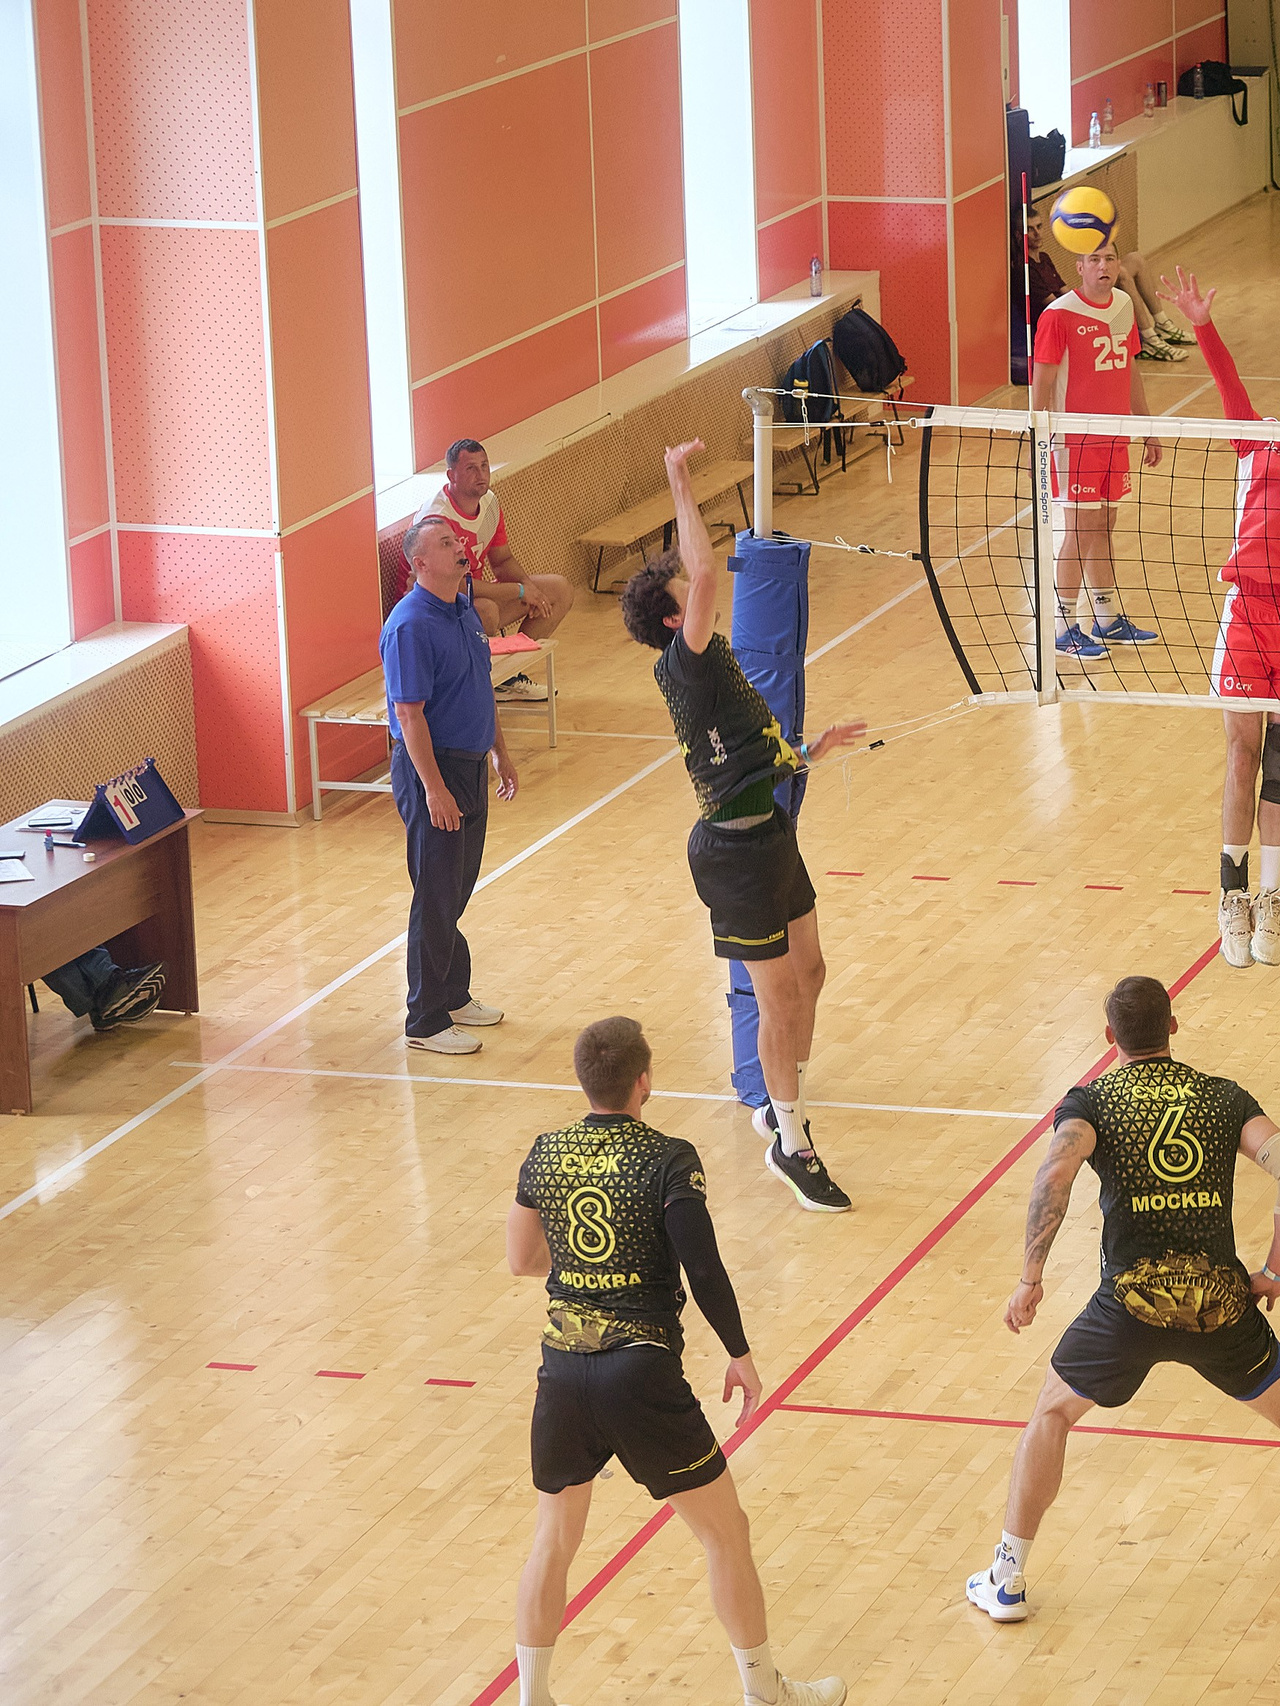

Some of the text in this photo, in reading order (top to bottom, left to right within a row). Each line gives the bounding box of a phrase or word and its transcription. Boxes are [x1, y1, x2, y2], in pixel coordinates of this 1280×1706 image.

[1093, 334, 1128, 372] 25
[1040, 451, 1050, 524] Schelde Sports
[113, 795, 134, 825] 1
[1131, 1082, 1198, 1102] СУЭК
[1147, 1103, 1204, 1184] 6
[560, 1153, 622, 1175] СУЭК
[1131, 1191, 1223, 1213] МОСКВА
[566, 1186, 616, 1264] 8
[558, 1270, 643, 1290] МОСКВА
